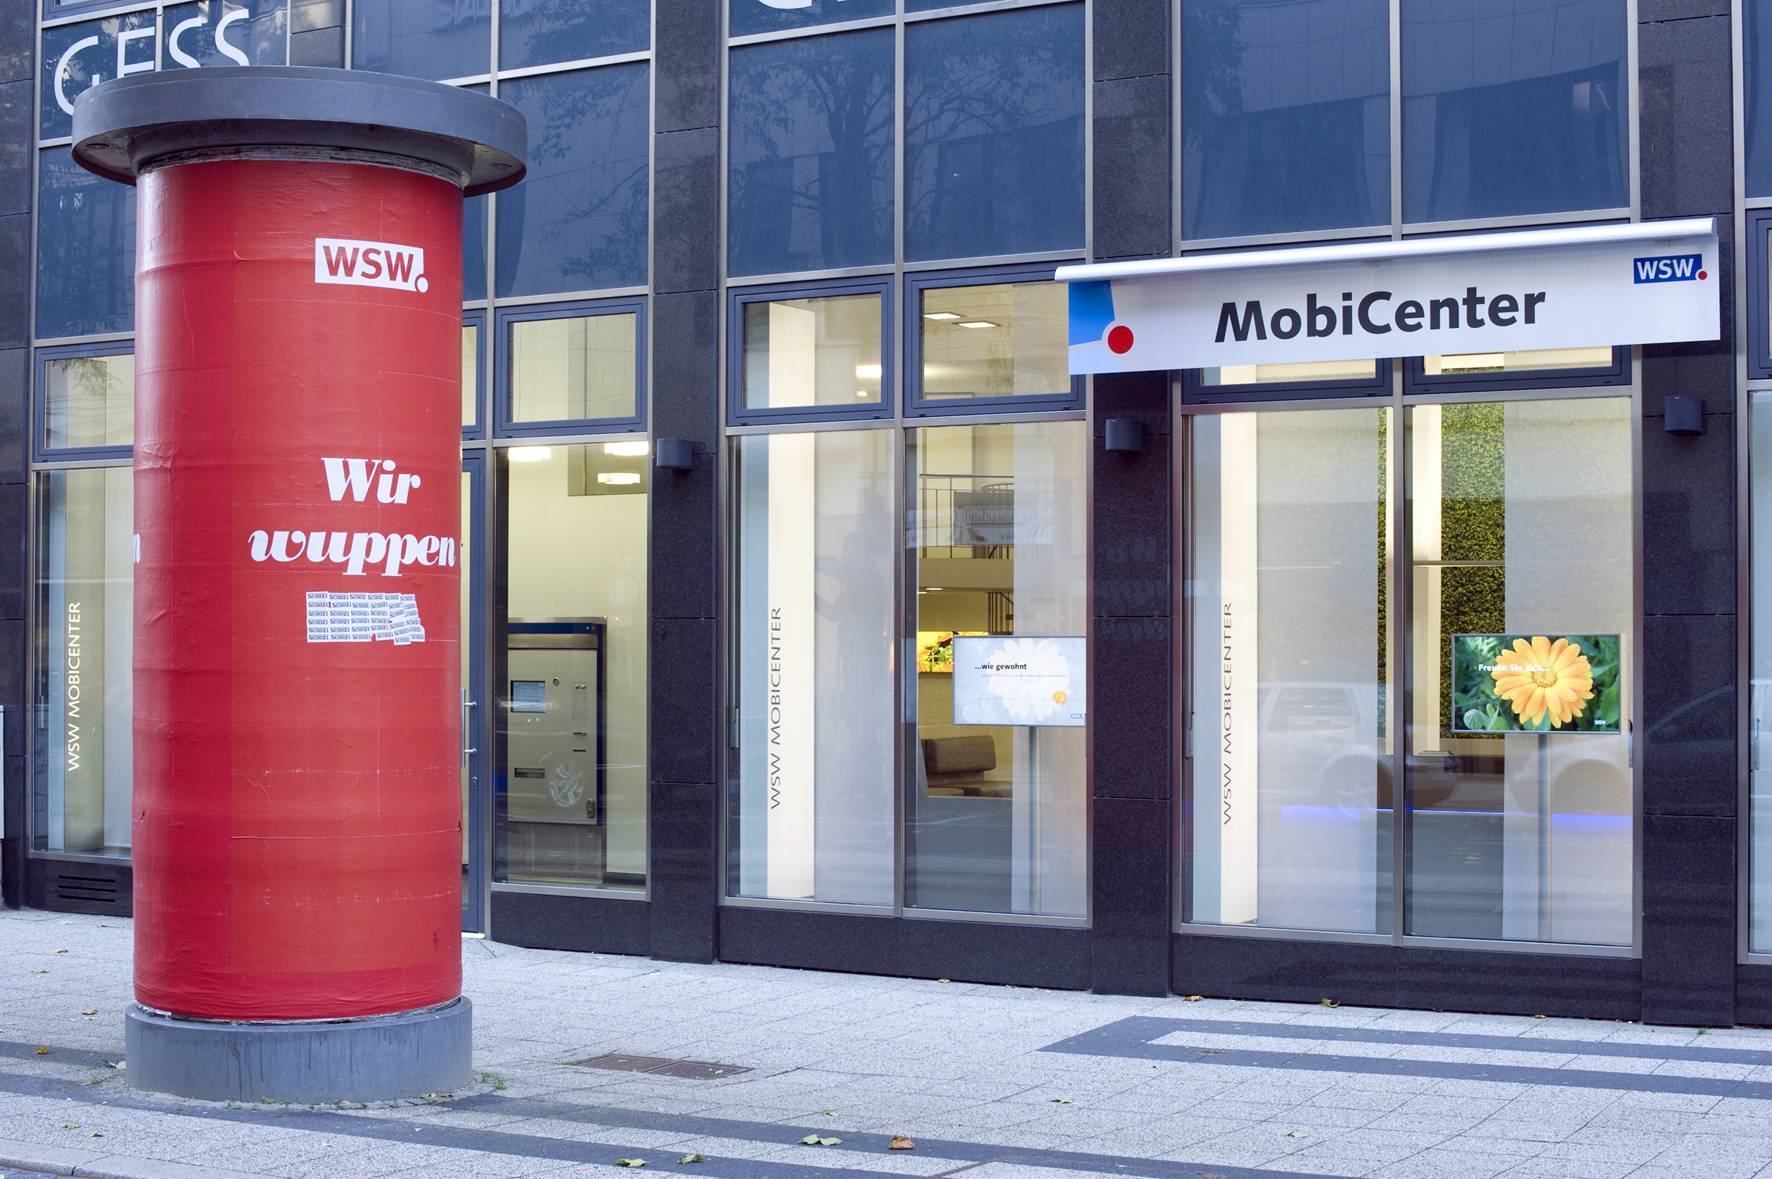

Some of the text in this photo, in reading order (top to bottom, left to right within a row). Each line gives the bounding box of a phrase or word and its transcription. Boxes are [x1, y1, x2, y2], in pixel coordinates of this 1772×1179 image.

[1214, 286, 1546, 343] MobiCenter
[320, 457, 422, 505] Wir
[248, 530, 456, 577] wuppen
[68, 602, 80, 771] WSW MOBICENTER
[995, 663, 1027, 671] gewohnt
[771, 608, 781, 809] WSW MOBICENTER
[1223, 602, 1232, 824] WSW MOBICENTER
